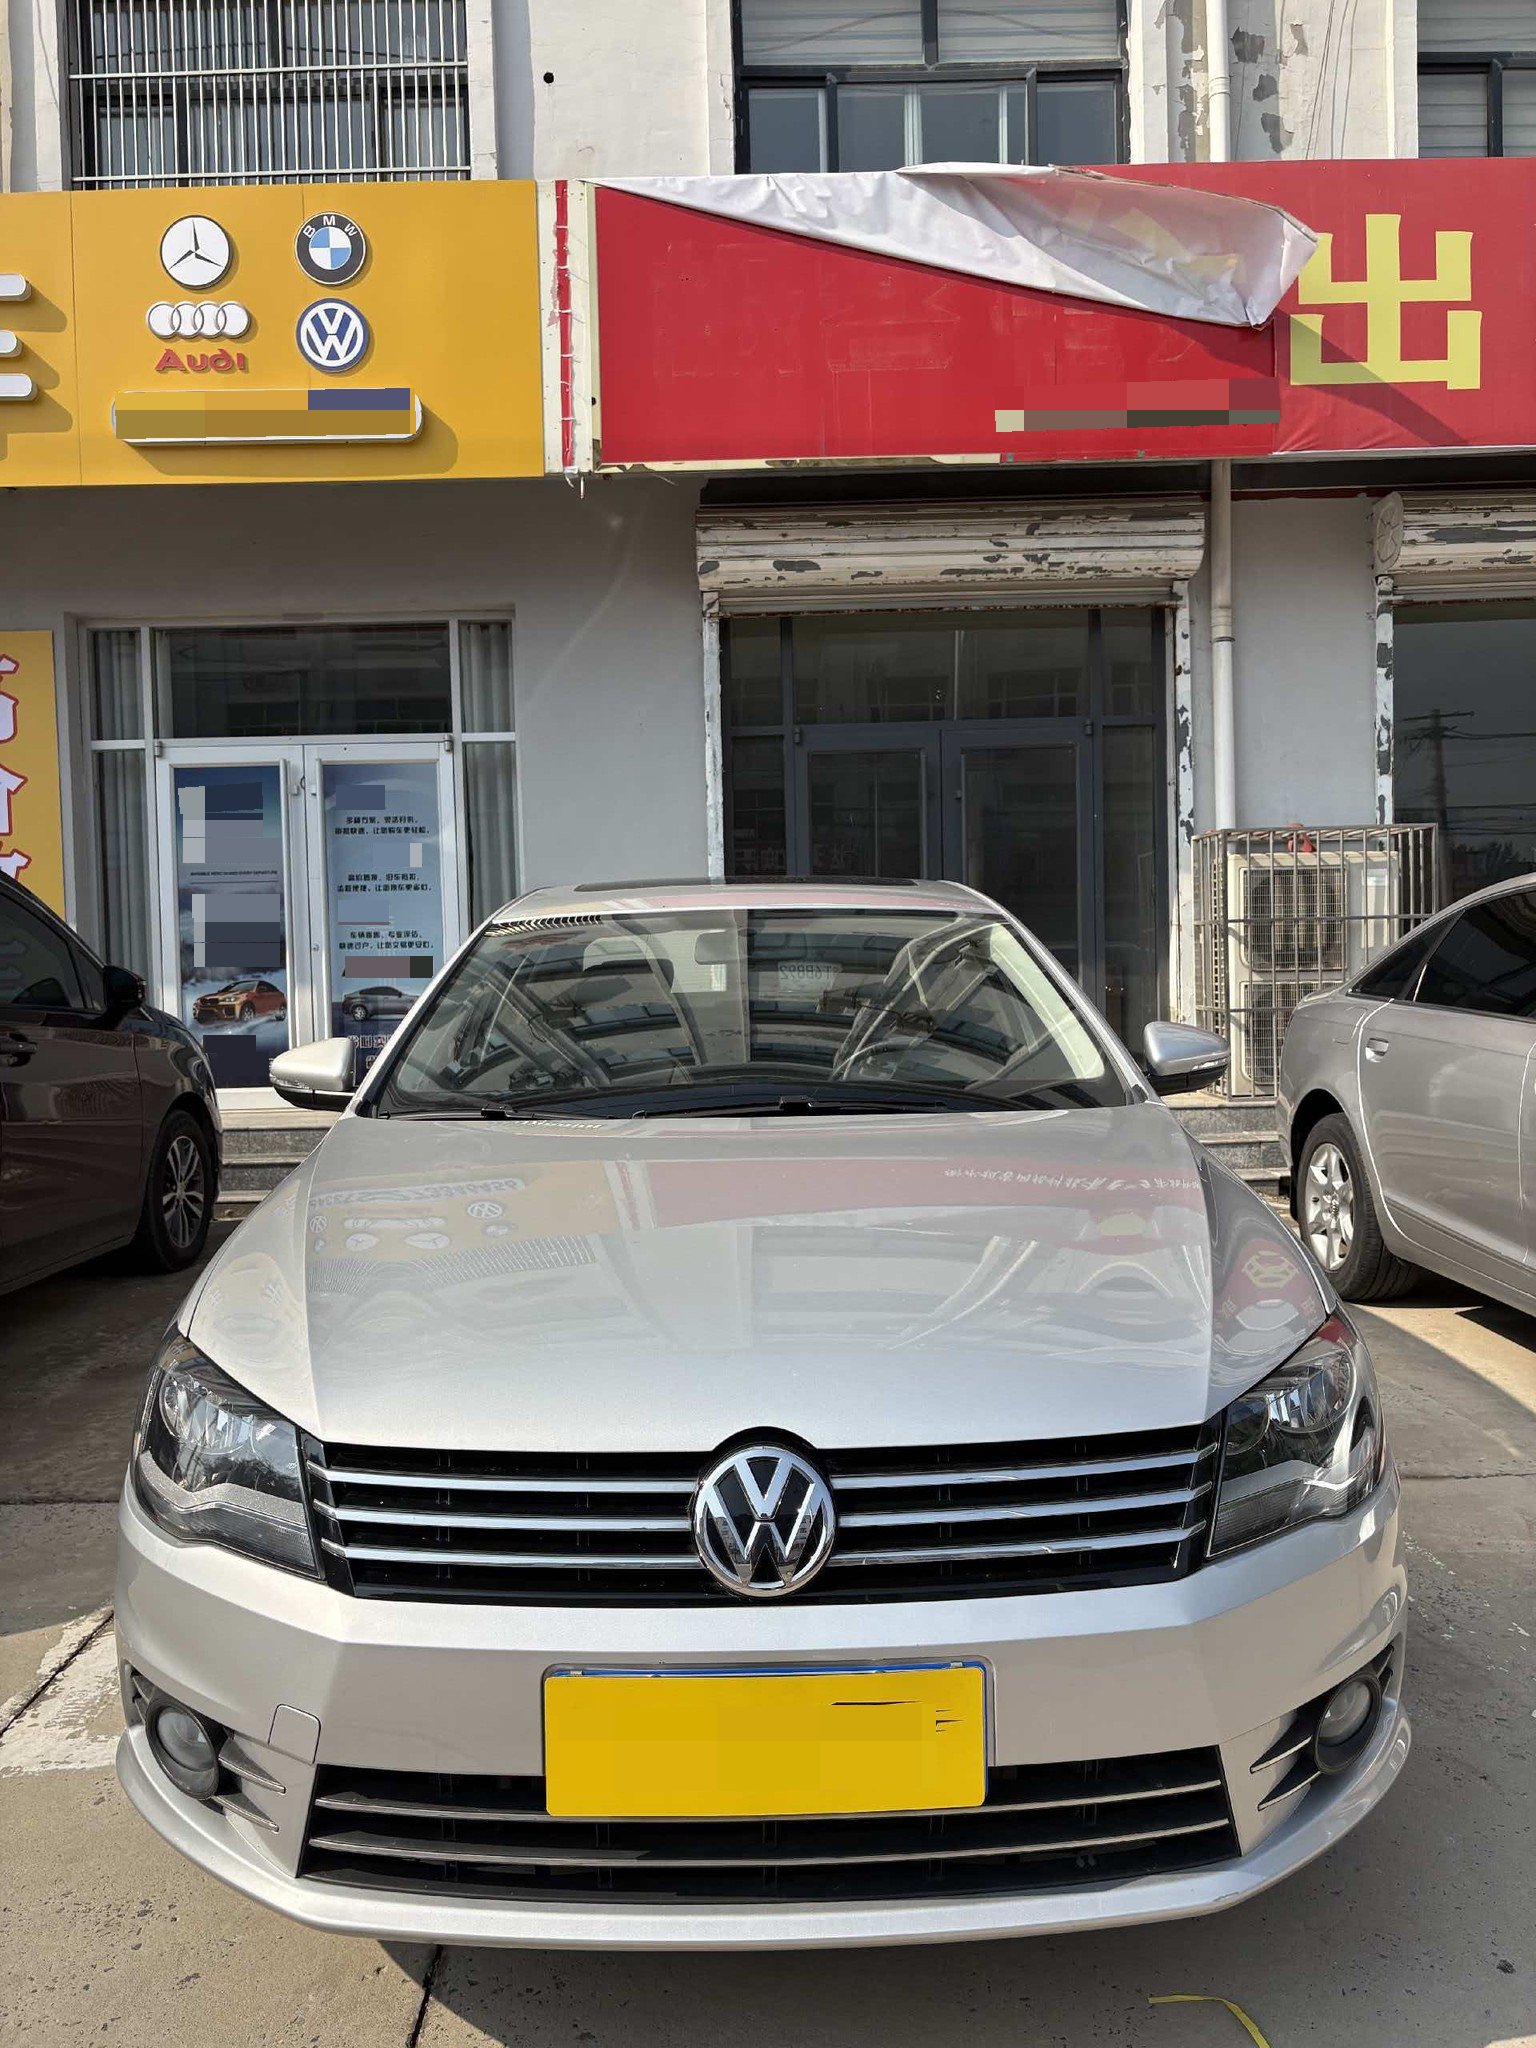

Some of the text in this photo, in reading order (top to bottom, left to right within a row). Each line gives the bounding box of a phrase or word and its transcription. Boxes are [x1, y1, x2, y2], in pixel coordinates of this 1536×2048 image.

[302, 215, 357, 239] BMW
[1290, 213, 1482, 390] 出
[154, 348, 246, 372] Audi
